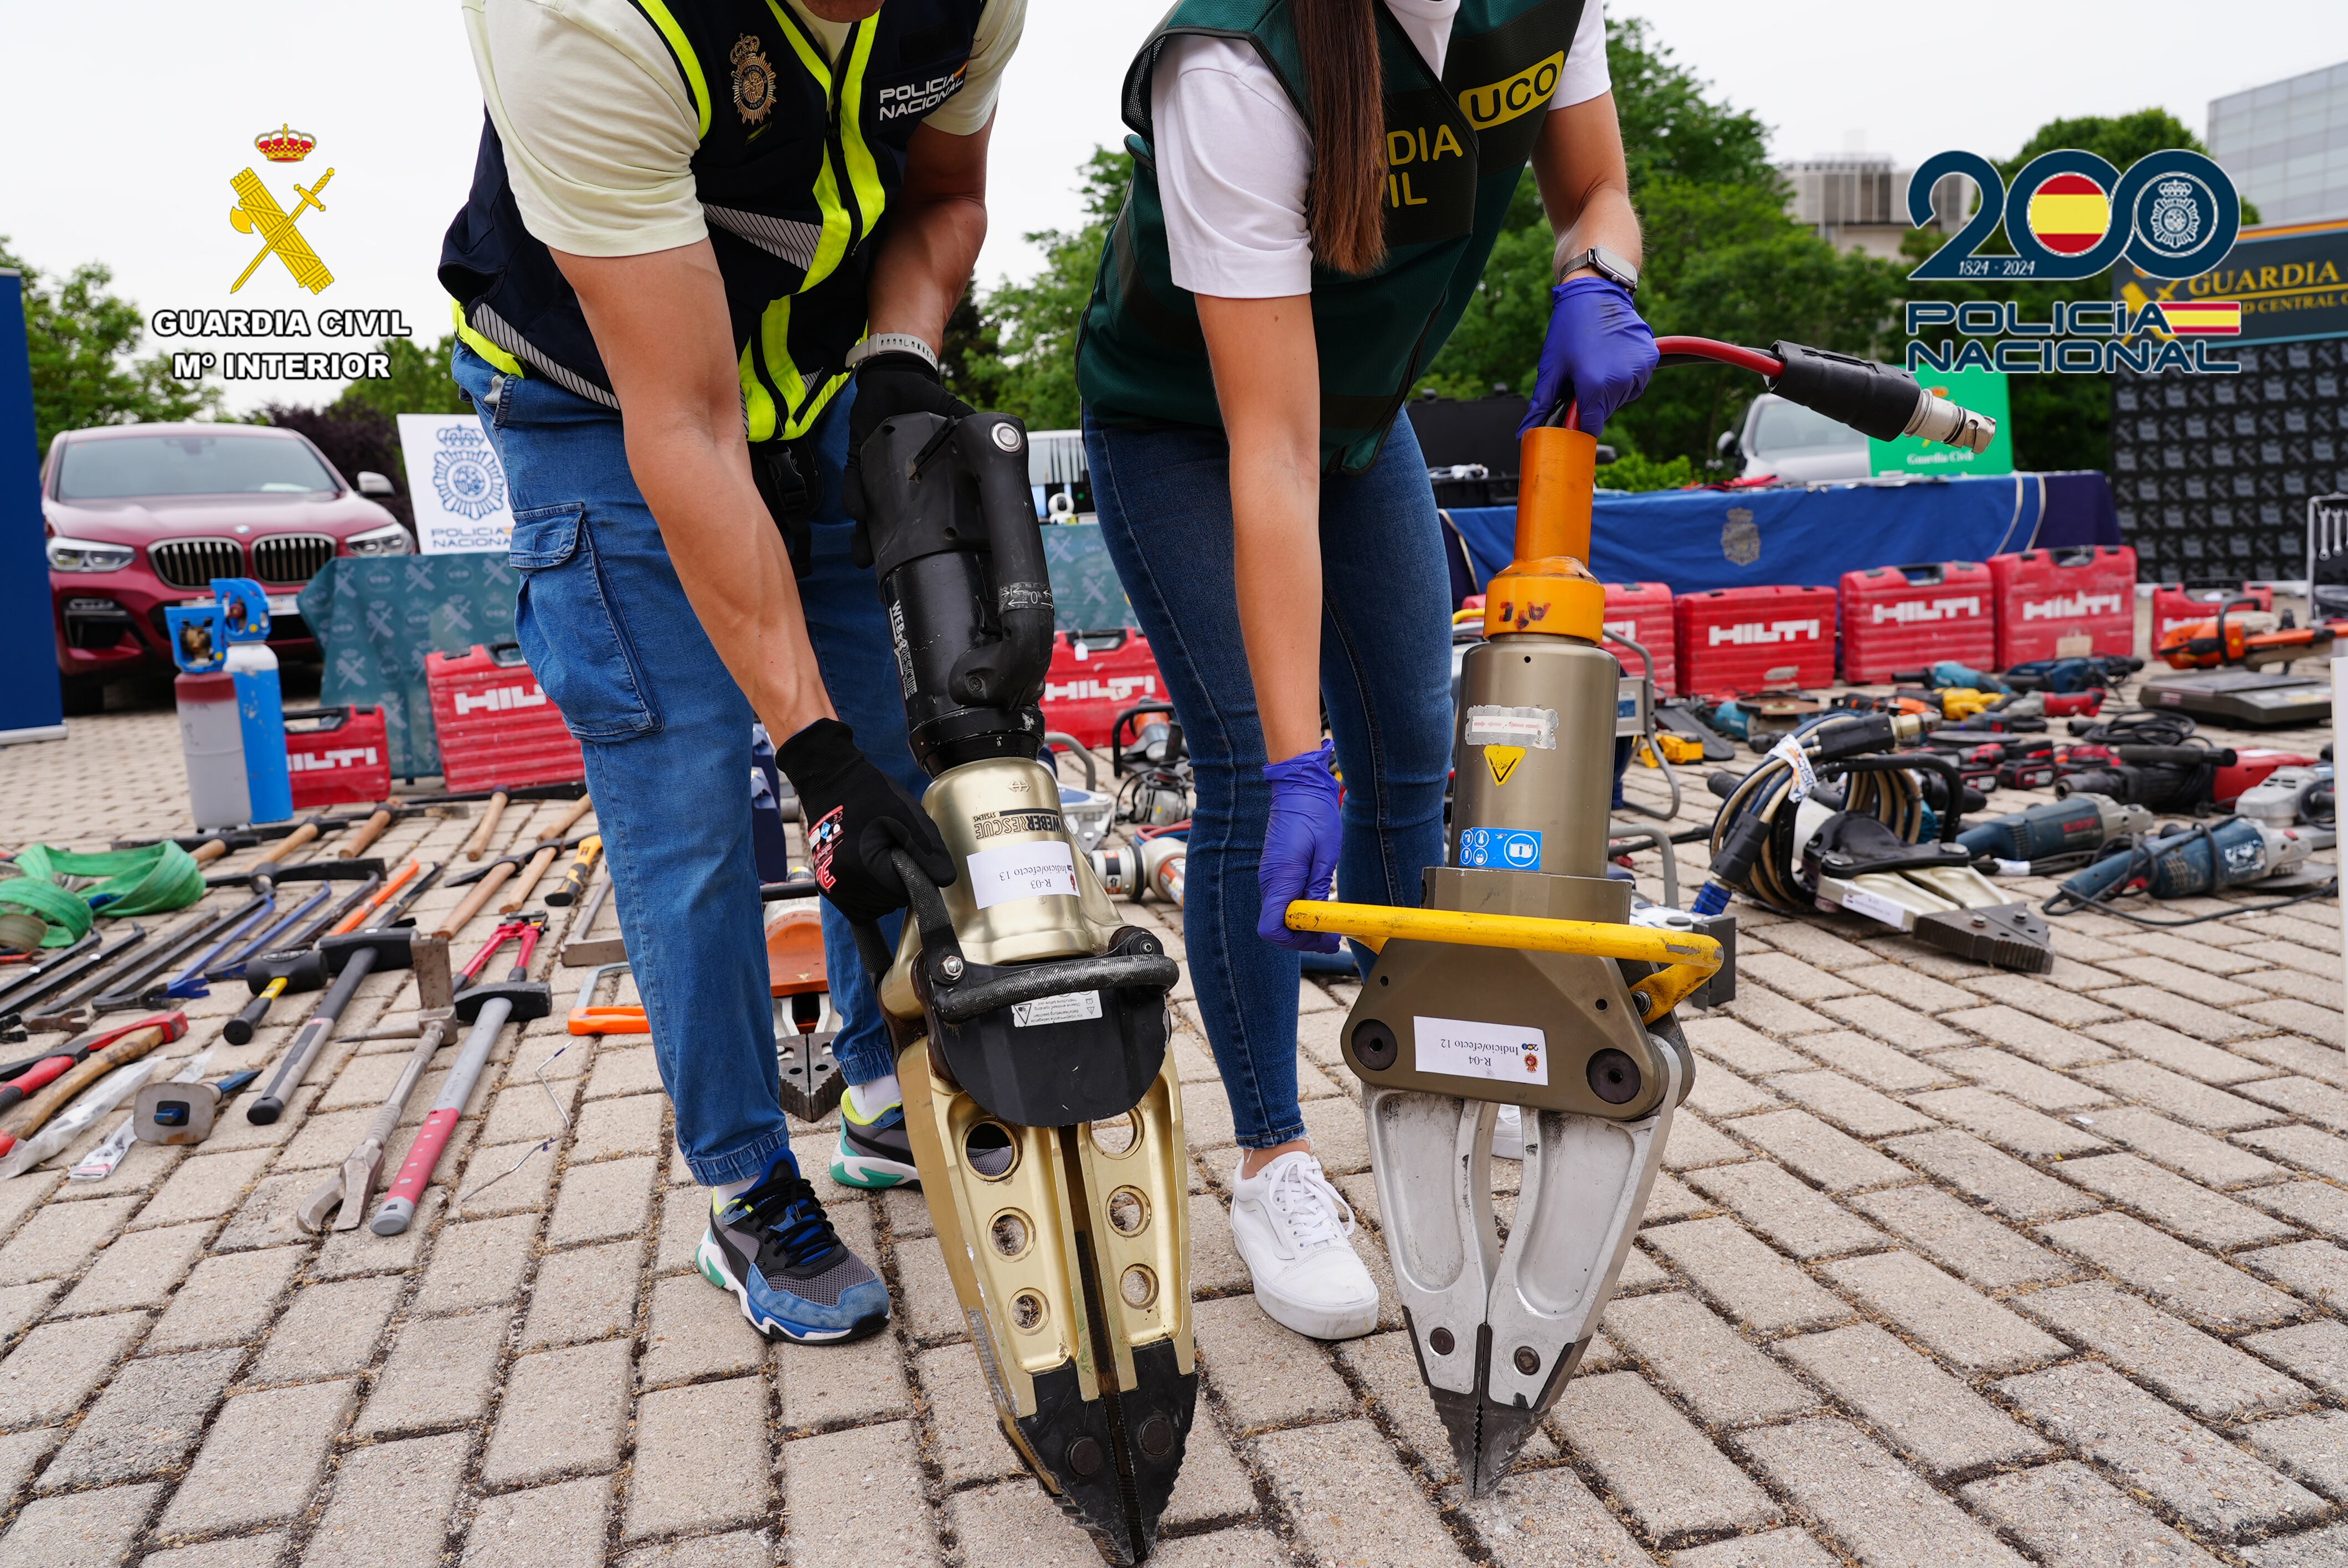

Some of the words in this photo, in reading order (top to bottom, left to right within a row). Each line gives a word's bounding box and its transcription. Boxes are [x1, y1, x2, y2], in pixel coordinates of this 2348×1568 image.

[879, 78, 964, 121] NACIONAL
[1470, 63, 1557, 122] UCO
[2188, 260, 2340, 296] GUARDIA
[2258, 294, 2339, 314] CENTRAL
[434, 537, 511, 548] NACIONA
[1872, 596, 1981, 625] HILTI
[1708, 618, 1820, 646] HILTI
[1045, 675, 1156, 702] HILTI
[454, 683, 547, 715] HIL
[287, 747, 378, 772] ILTI
[973, 812, 996, 822] SYSTEMS
[999, 871, 1010, 881] 13
[1014, 865, 1067, 875] Indicio/efecto
[1031, 879, 1052, 889] R-03
[1441, 1039, 1450, 1048] 12
[1455, 1040, 1519, 1055] Indicio/efecto
[1469, 1056, 1491, 1066] R-04
